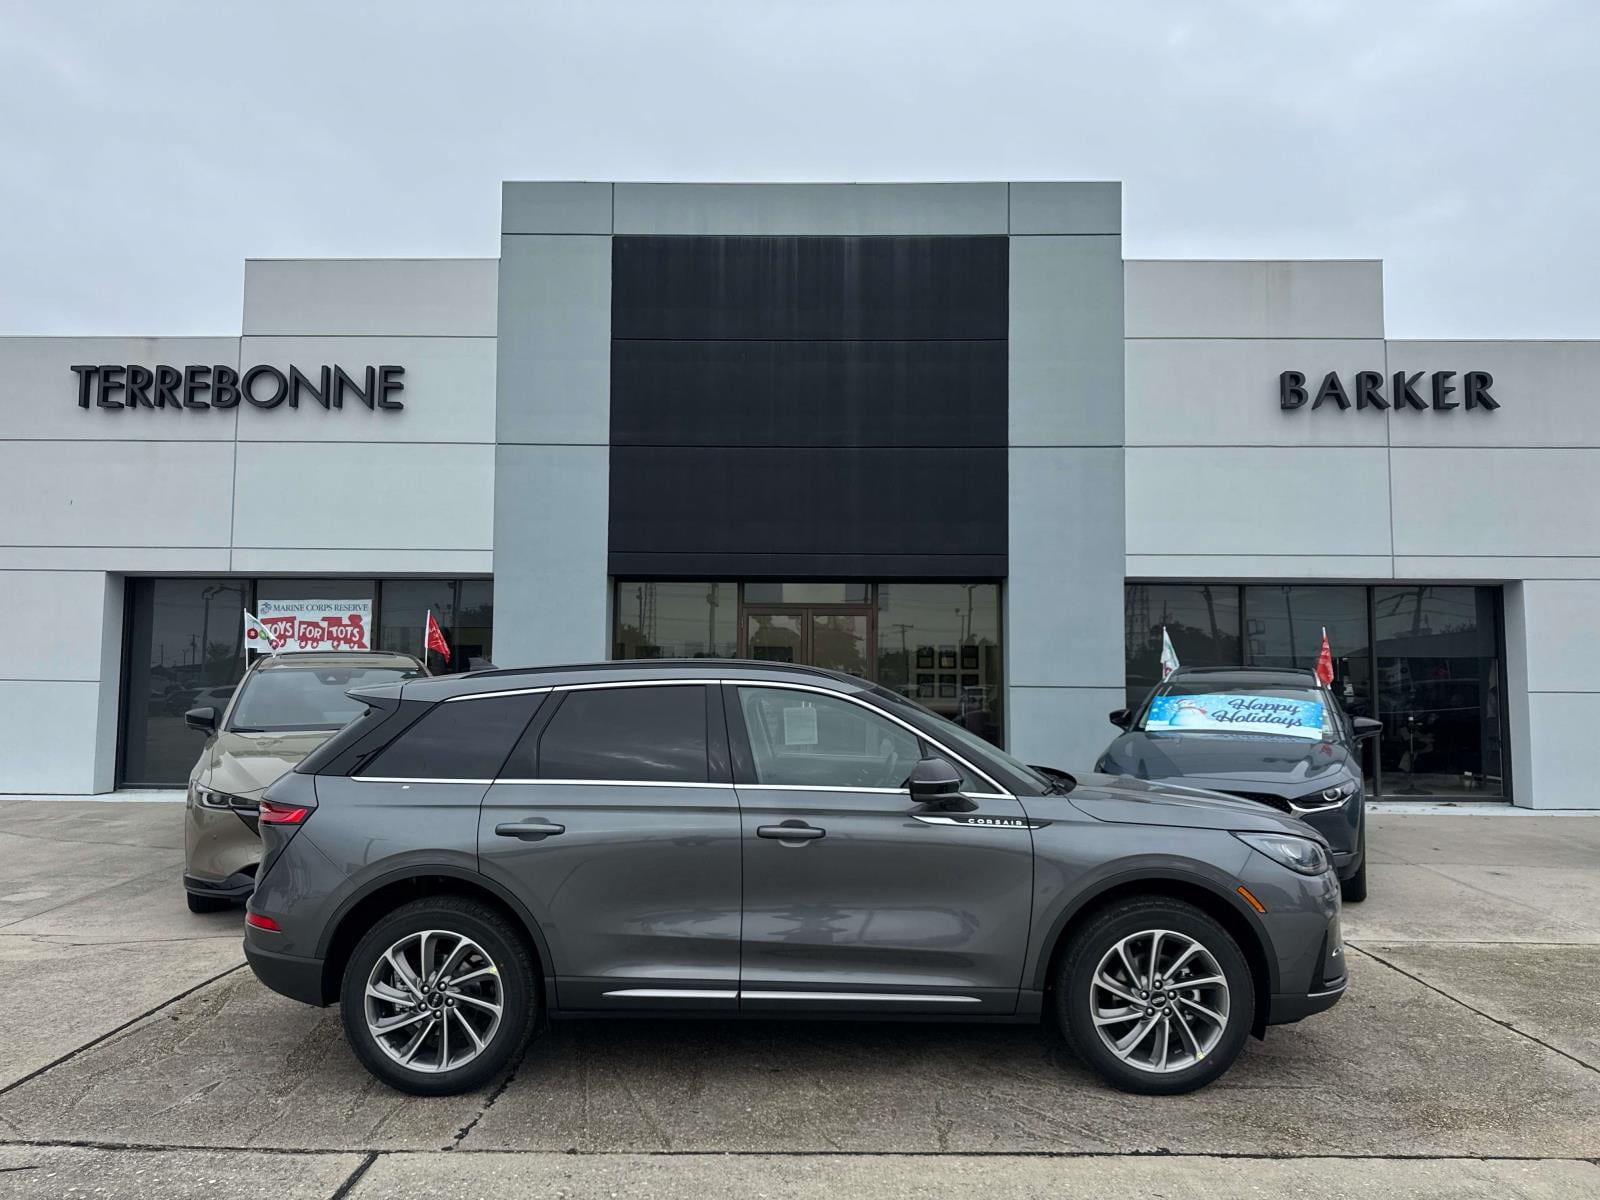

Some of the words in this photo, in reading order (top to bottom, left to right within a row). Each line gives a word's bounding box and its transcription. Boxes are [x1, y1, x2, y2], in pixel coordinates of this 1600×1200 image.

[70, 364, 405, 410] TERREBONNE
[1280, 370, 1501, 411] BARKER
[272, 603, 304, 612] MARINE
[306, 603, 333, 612] CORPS
[334, 603, 369, 612] RESERVE
[299, 624, 321, 639] FOR
[329, 626, 360, 641] TOTS
[1228, 698, 1301, 715] Happy
[1211, 710, 1302, 728] Holidays
[968, 818, 1022, 826] CORSAIR
